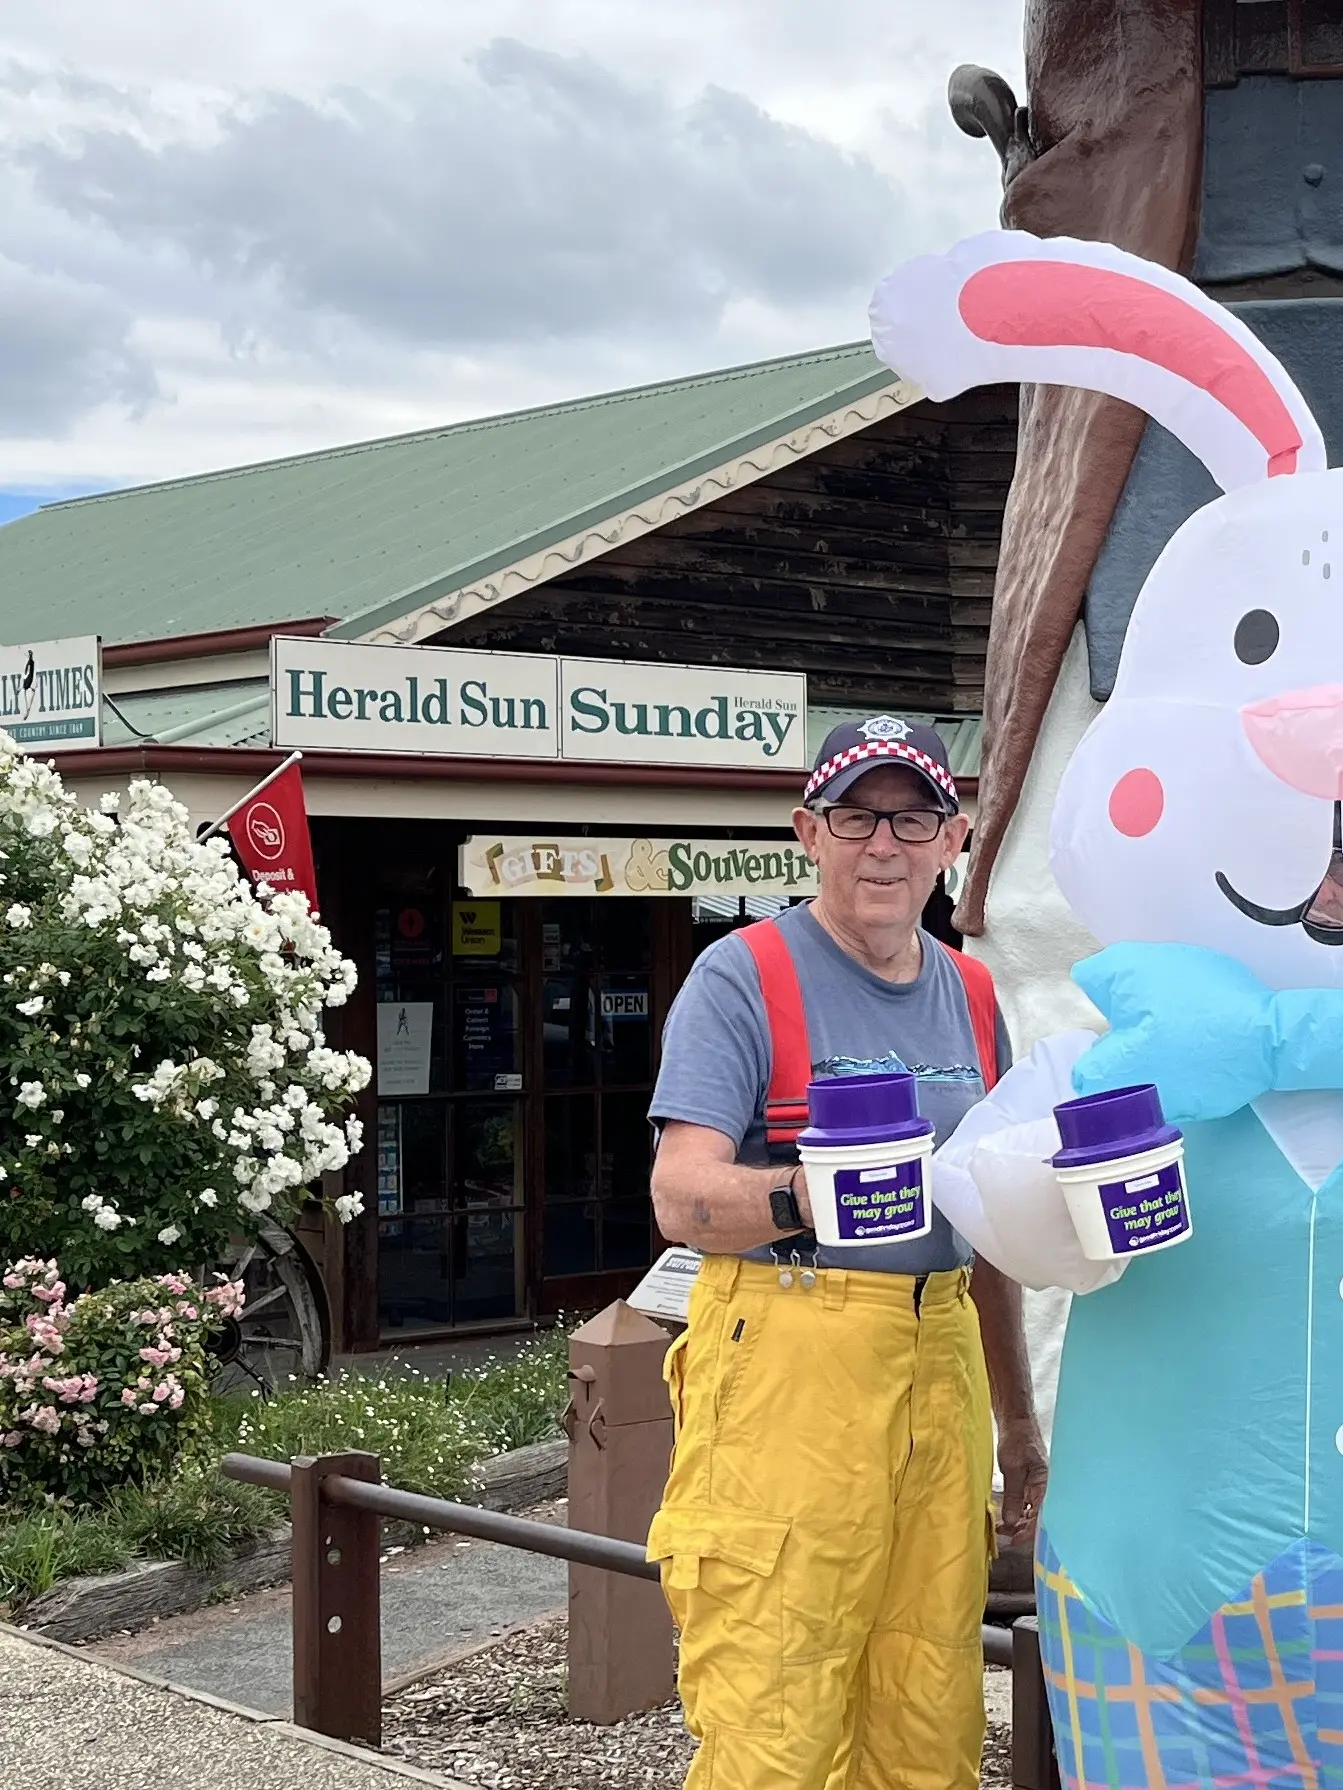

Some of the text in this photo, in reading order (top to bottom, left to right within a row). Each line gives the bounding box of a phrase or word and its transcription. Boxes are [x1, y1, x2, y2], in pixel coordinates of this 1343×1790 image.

[0, 664, 94, 716] LY TIMES
[285, 669, 550, 730] Herald Sun
[735, 696, 797, 711] Herald Sun
[19, 726, 47, 738] COUNTRY
[49, 724, 67, 736] SINCE
[570, 687, 798, 757] Sunday
[251, 867, 295, 882] Deposit &
[502, 838, 820, 891] GIFTS & Souvenir
[603, 995, 644, 1014] OPEN
[840, 1185, 921, 1206] Give that they
[1109, 1188, 1182, 1220] Give that they
[852, 1201, 914, 1222] may grow
[1123, 1204, 1179, 1231] may grow
